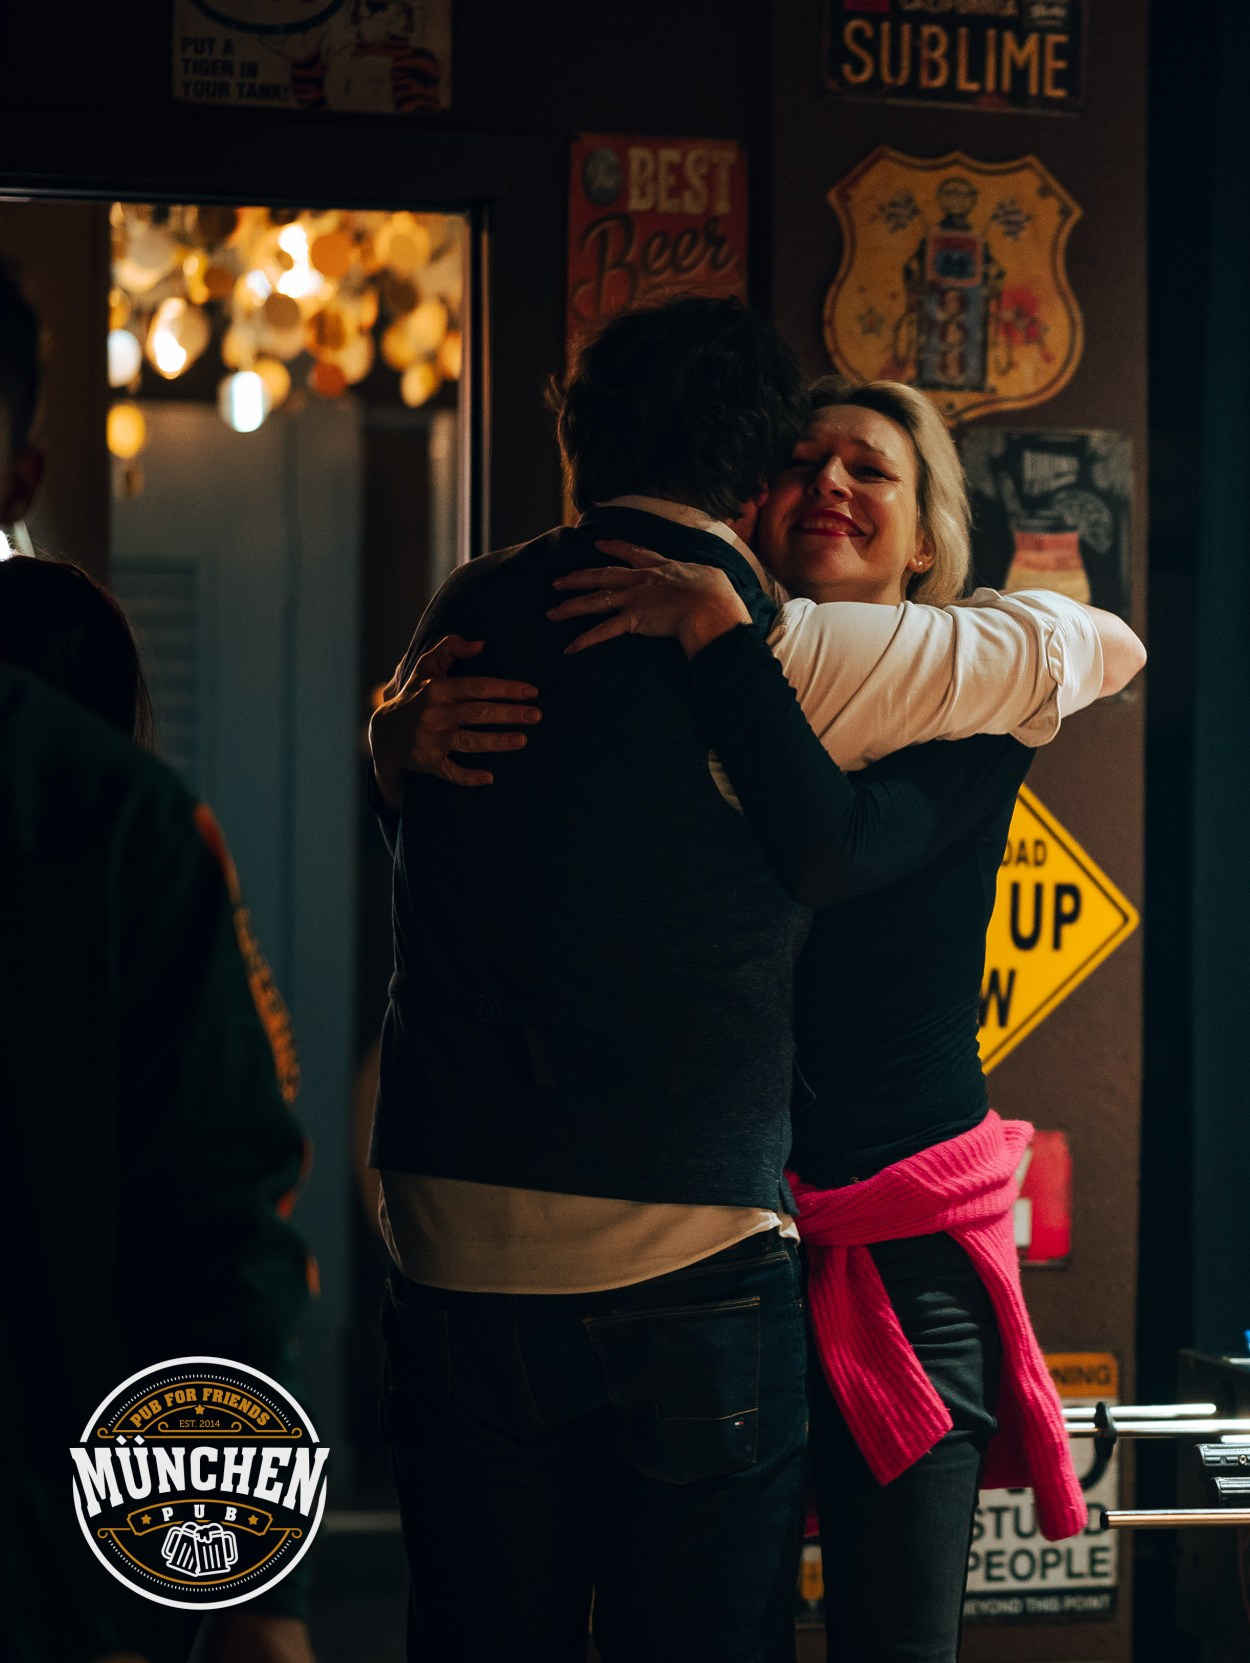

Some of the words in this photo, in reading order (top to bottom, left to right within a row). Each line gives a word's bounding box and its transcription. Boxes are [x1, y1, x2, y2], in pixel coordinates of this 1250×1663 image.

[181, 36, 221, 56] PUT
[223, 38, 236, 56] A
[841, 17, 1071, 99] SUBLIME
[181, 58, 234, 77] TIGER
[240, 61, 259, 79] IN
[181, 79, 231, 99] YOUR
[626, 146, 738, 216] BEST
[573, 211, 736, 323] Beer
[1010, 882, 1082, 951] UP
[971, 1502, 1107, 1540] STUD
[967, 1546, 1112, 1582] PEOPLE
